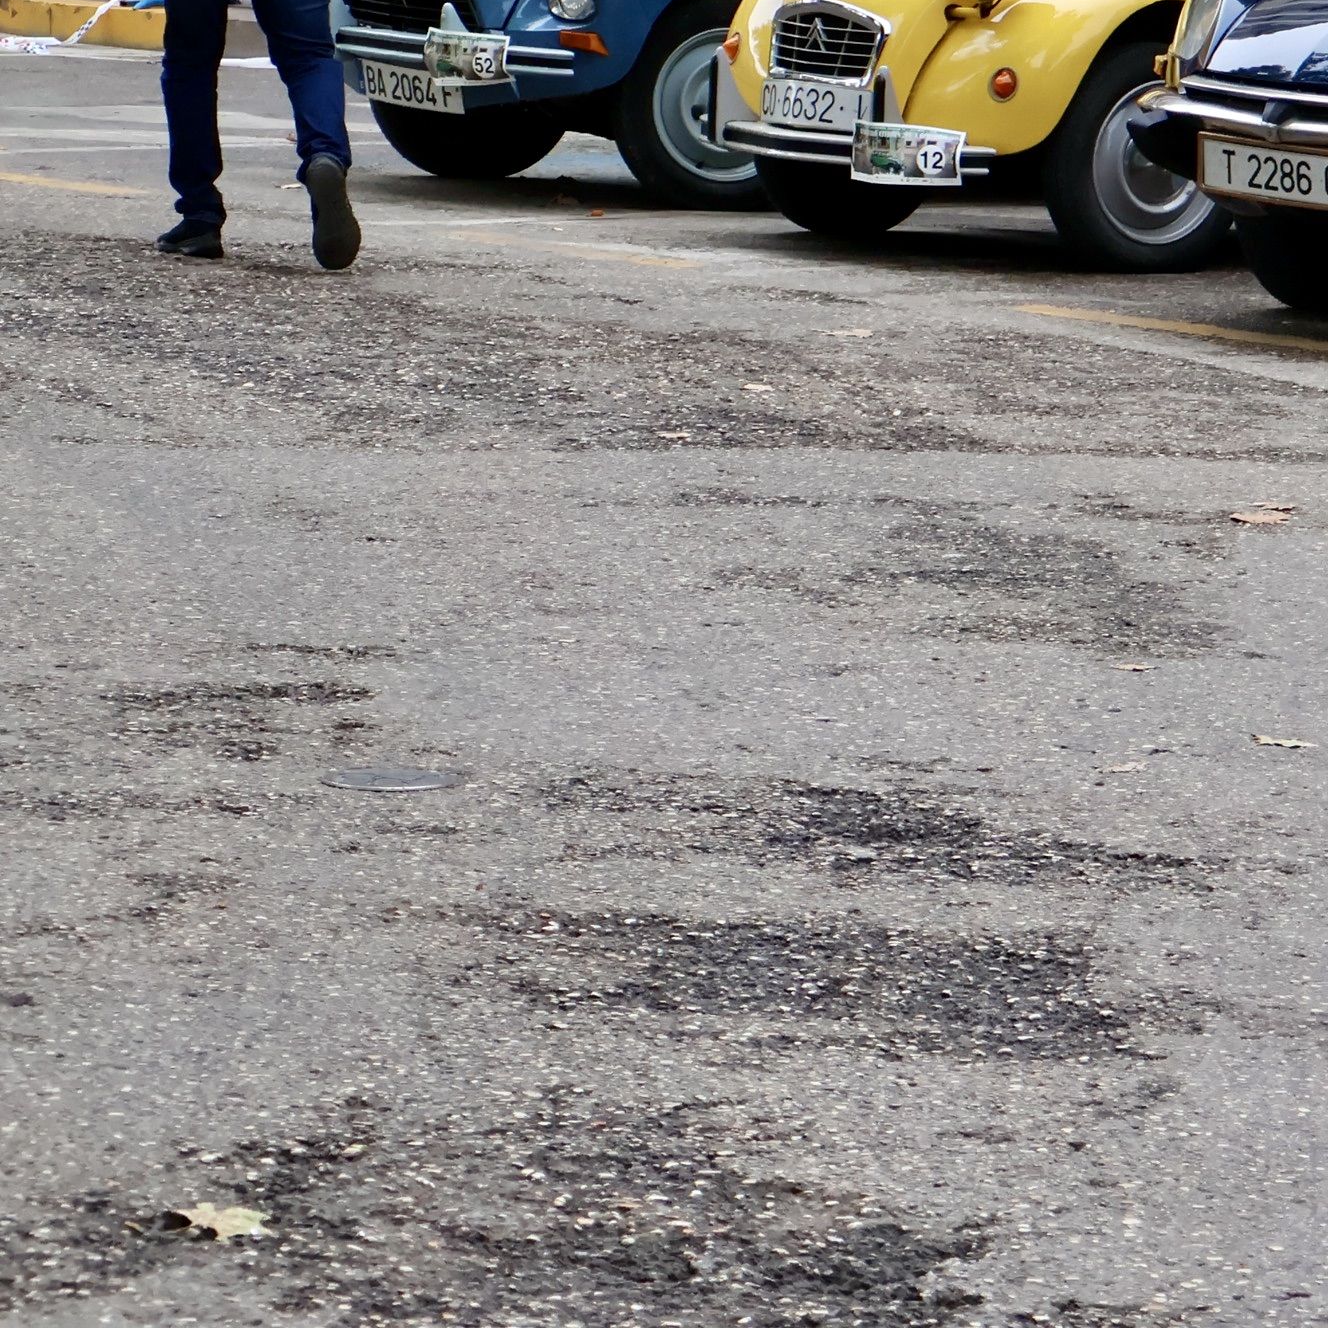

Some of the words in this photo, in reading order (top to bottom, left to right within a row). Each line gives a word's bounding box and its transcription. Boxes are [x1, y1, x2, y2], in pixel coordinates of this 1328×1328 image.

[474, 57, 495, 74] 52
[365, 65, 387, 97] BA
[389, 71, 437, 106] 2064
[919, 151, 943, 169] 12
[1222, 149, 1236, 184] T
[1247, 154, 1312, 195] 2286
